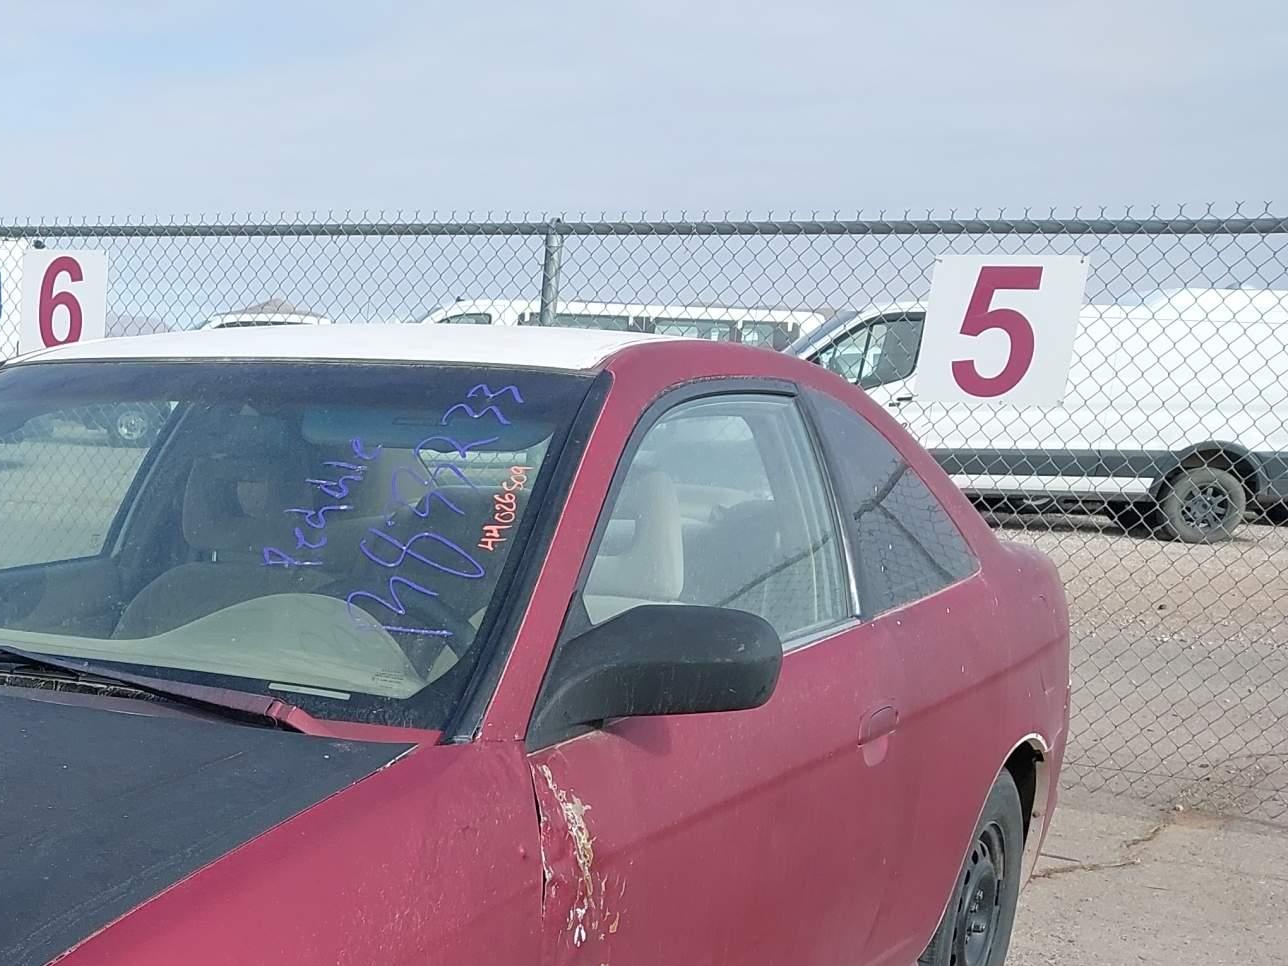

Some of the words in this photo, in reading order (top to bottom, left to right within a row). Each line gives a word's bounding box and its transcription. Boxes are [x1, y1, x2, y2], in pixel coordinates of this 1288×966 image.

[38, 256, 83, 348] 6
[951, 265, 1043, 397] 5
[477, 465, 535, 551] 44026509
